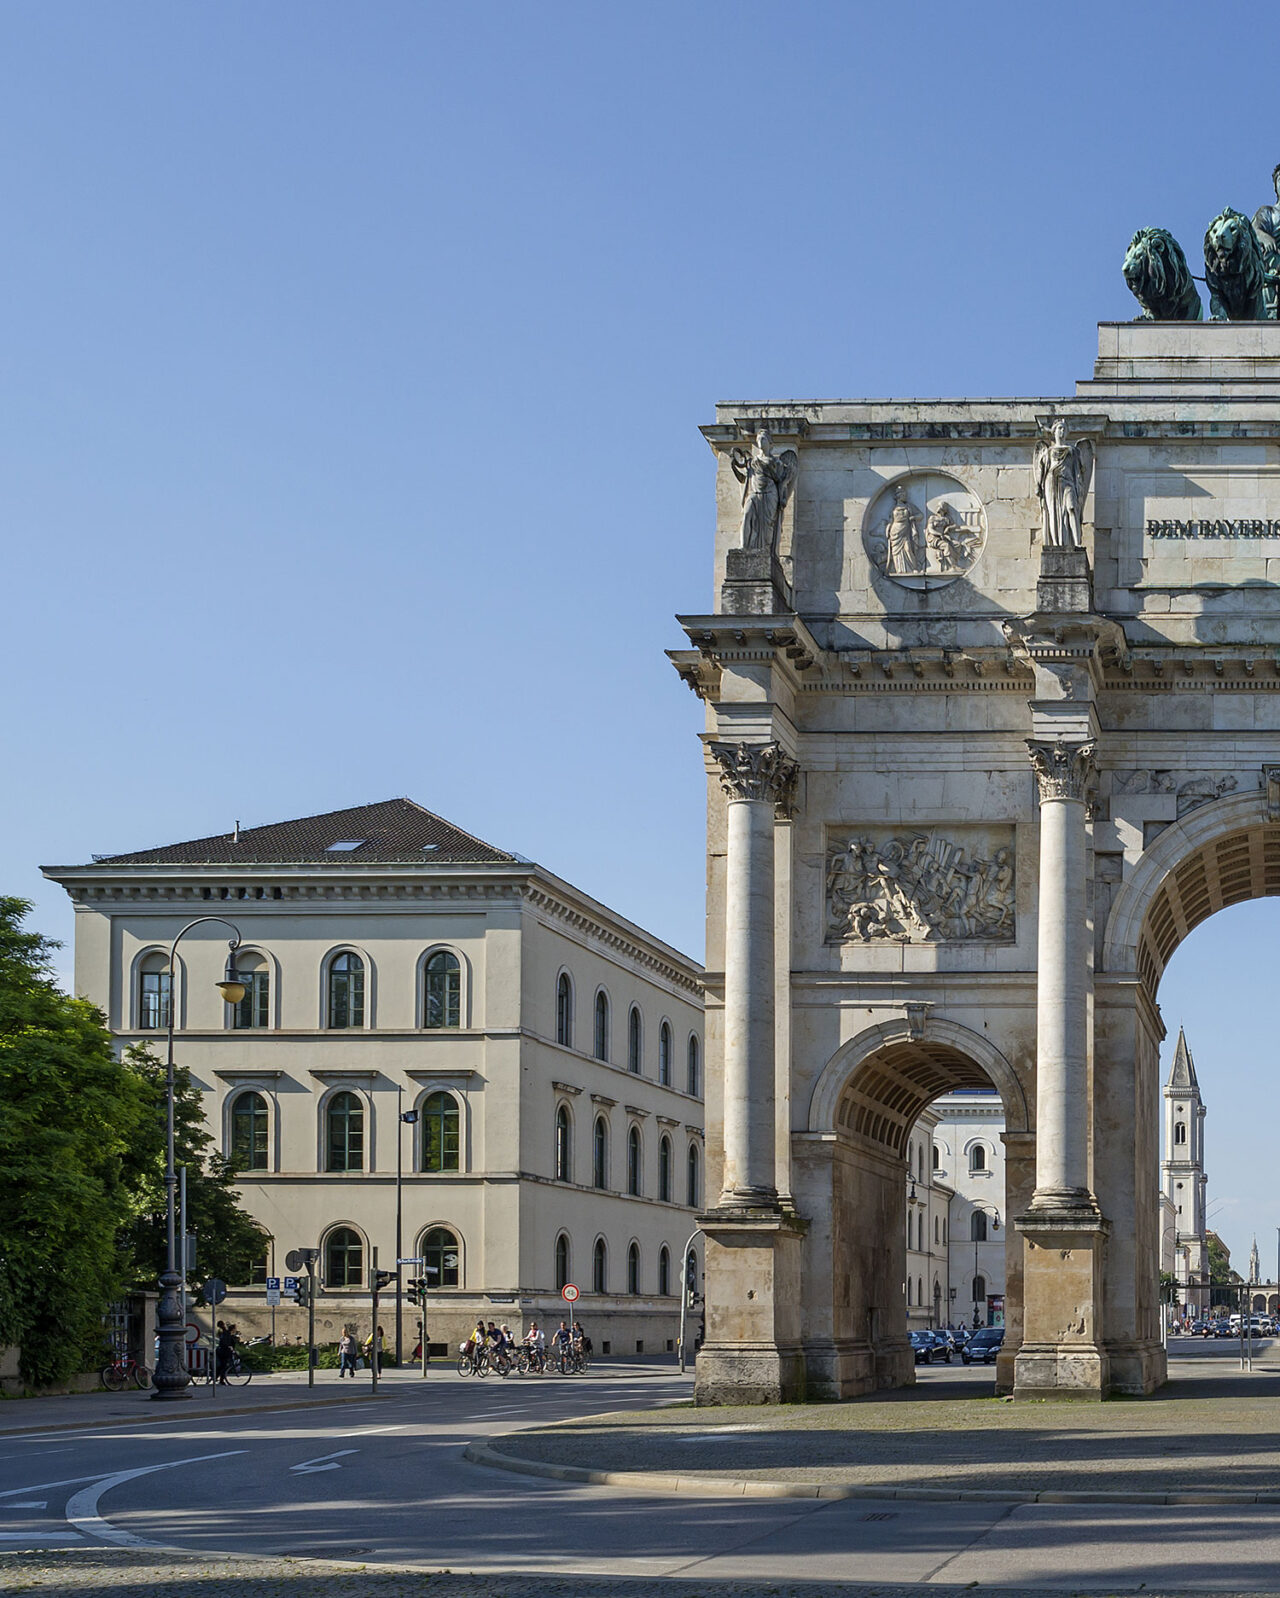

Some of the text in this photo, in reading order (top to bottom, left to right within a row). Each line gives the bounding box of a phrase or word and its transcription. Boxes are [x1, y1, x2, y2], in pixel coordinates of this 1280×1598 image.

[1146, 519, 1194, 536] DEM
[268, 1279, 276, 1288] P
[286, 1278, 294, 1288] P
